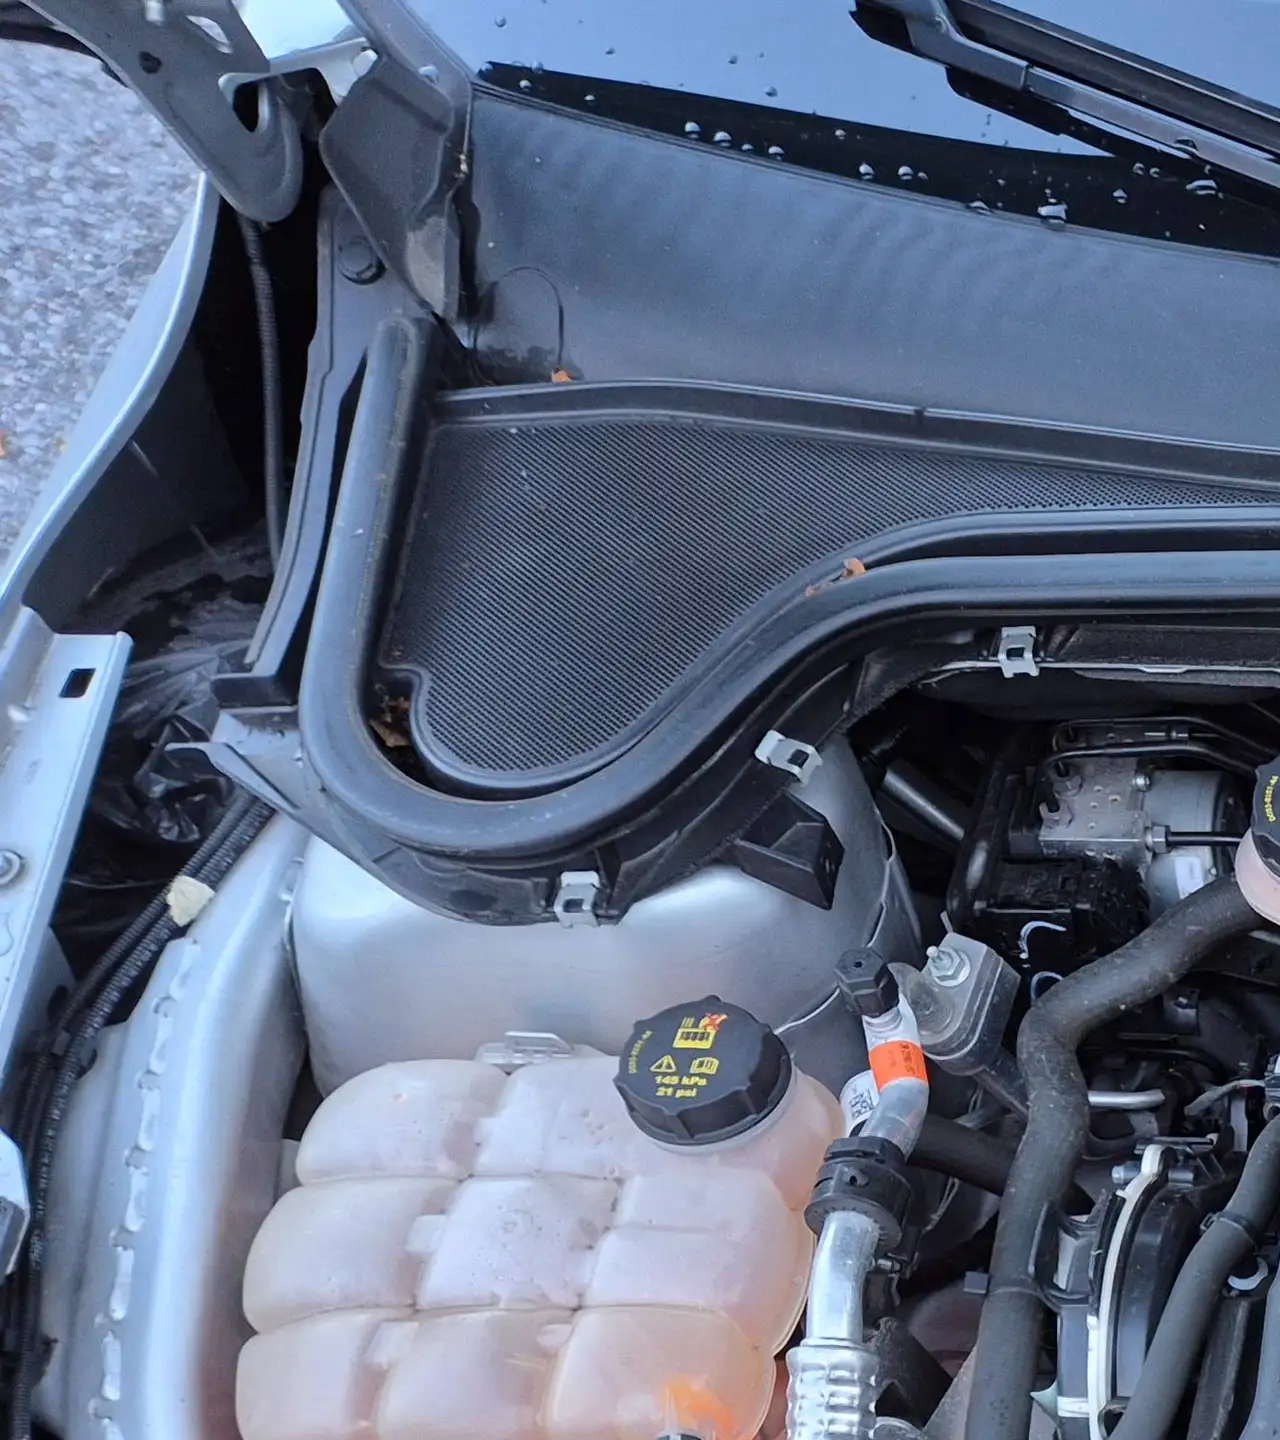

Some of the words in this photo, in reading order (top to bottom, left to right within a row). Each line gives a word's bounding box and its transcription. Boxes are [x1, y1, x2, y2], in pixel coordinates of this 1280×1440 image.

[655, 1075, 680, 1086] 145
[681, 1075, 708, 1086] kPa
[655, 1086, 673, 1097] 21
[675, 1087, 697, 1098] psi
